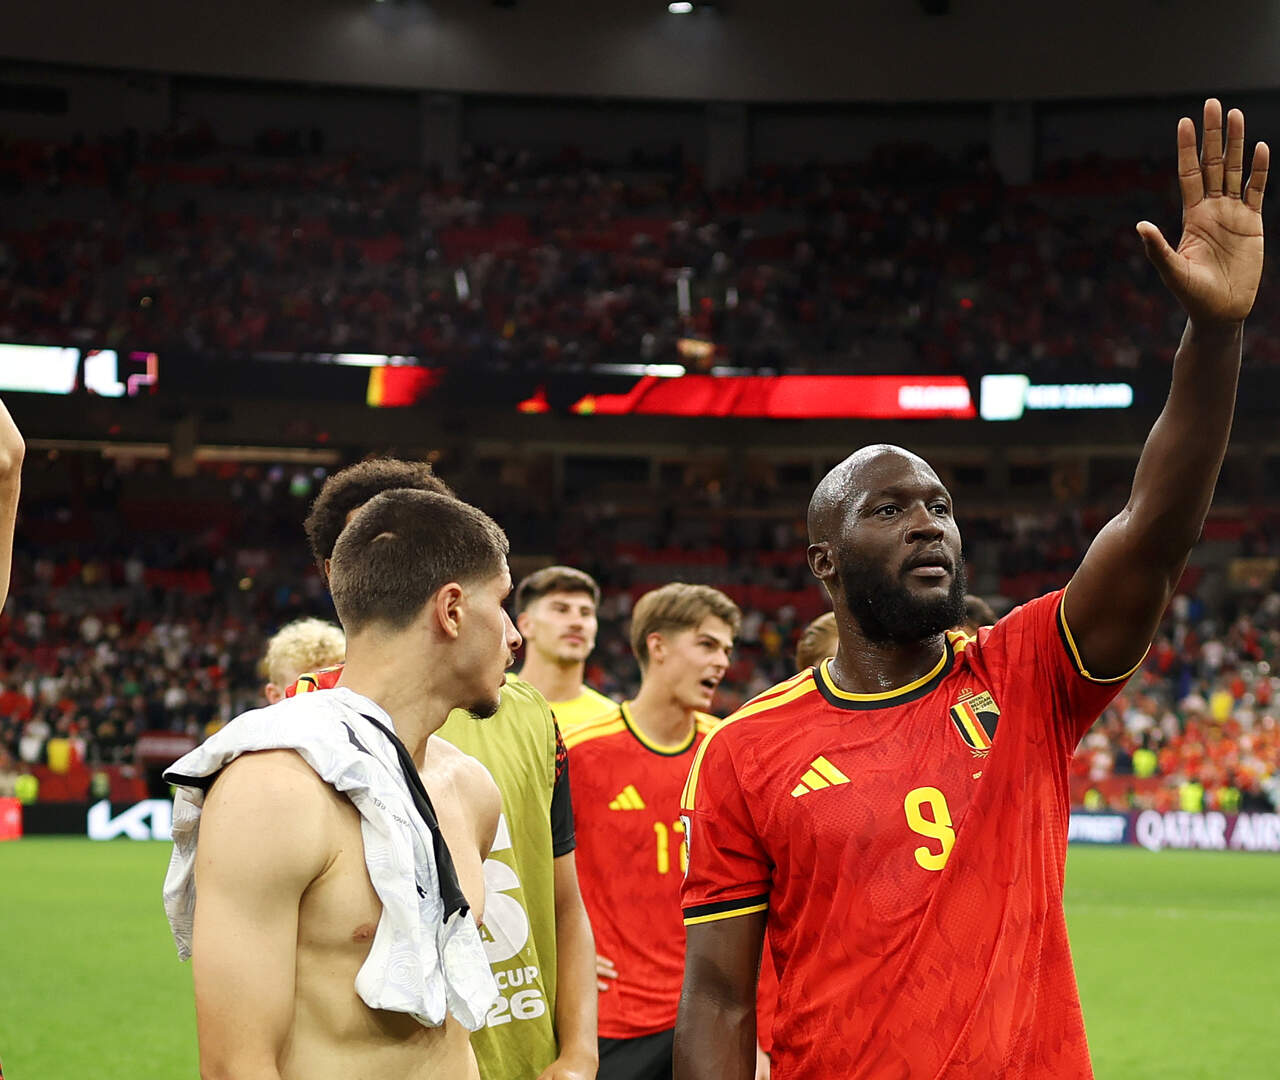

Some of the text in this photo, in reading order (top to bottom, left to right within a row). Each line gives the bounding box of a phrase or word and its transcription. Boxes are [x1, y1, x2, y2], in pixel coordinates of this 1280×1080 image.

[903, 785, 957, 872] 9
[1135, 810, 1228, 852] QATAR
[493, 965, 540, 991] CUP
[486, 989, 547, 1029] 26
